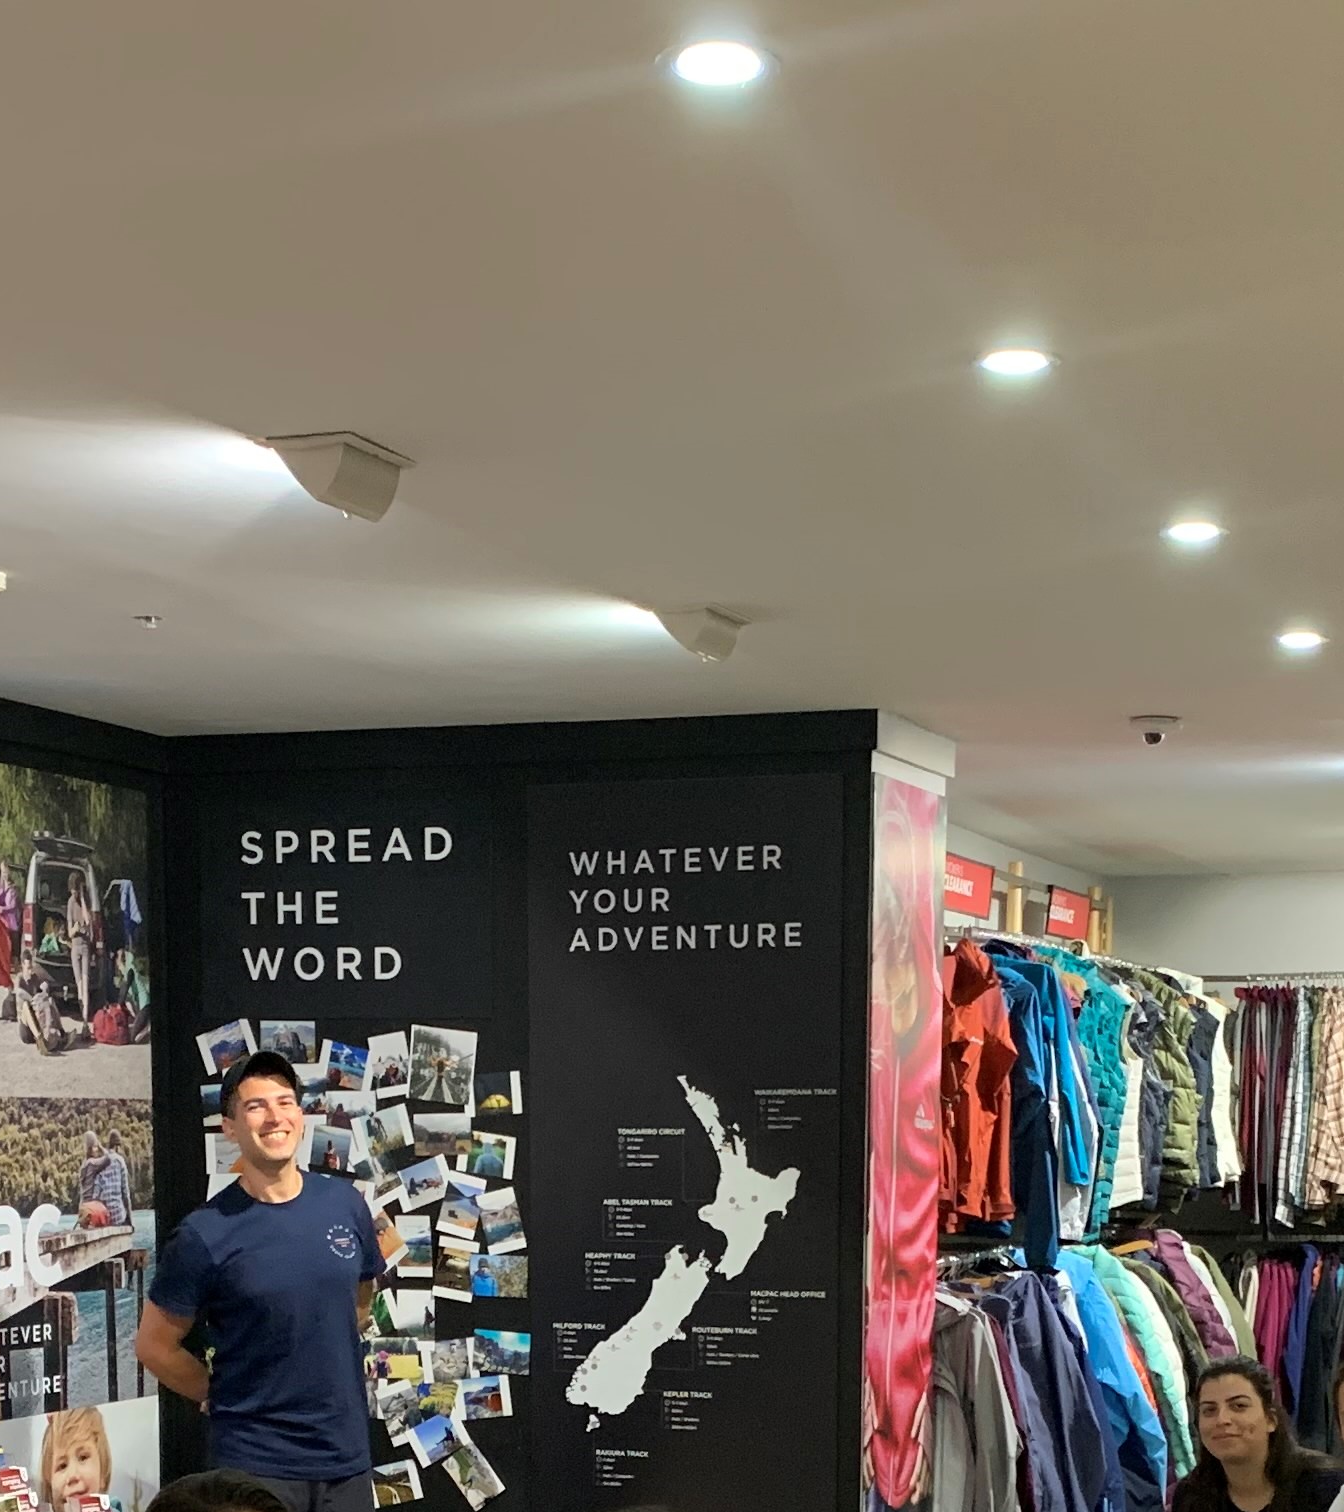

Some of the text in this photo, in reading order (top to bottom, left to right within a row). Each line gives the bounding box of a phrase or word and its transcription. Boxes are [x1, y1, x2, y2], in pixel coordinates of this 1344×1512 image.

[240, 826, 454, 865] SPREAD
[568, 844, 783, 876] WHATEVER
[240, 890, 340, 925] THE
[568, 887, 671, 915] YOUR
[568, 922, 803, 953] ADVENTURE
[242, 946, 403, 982] WORD
